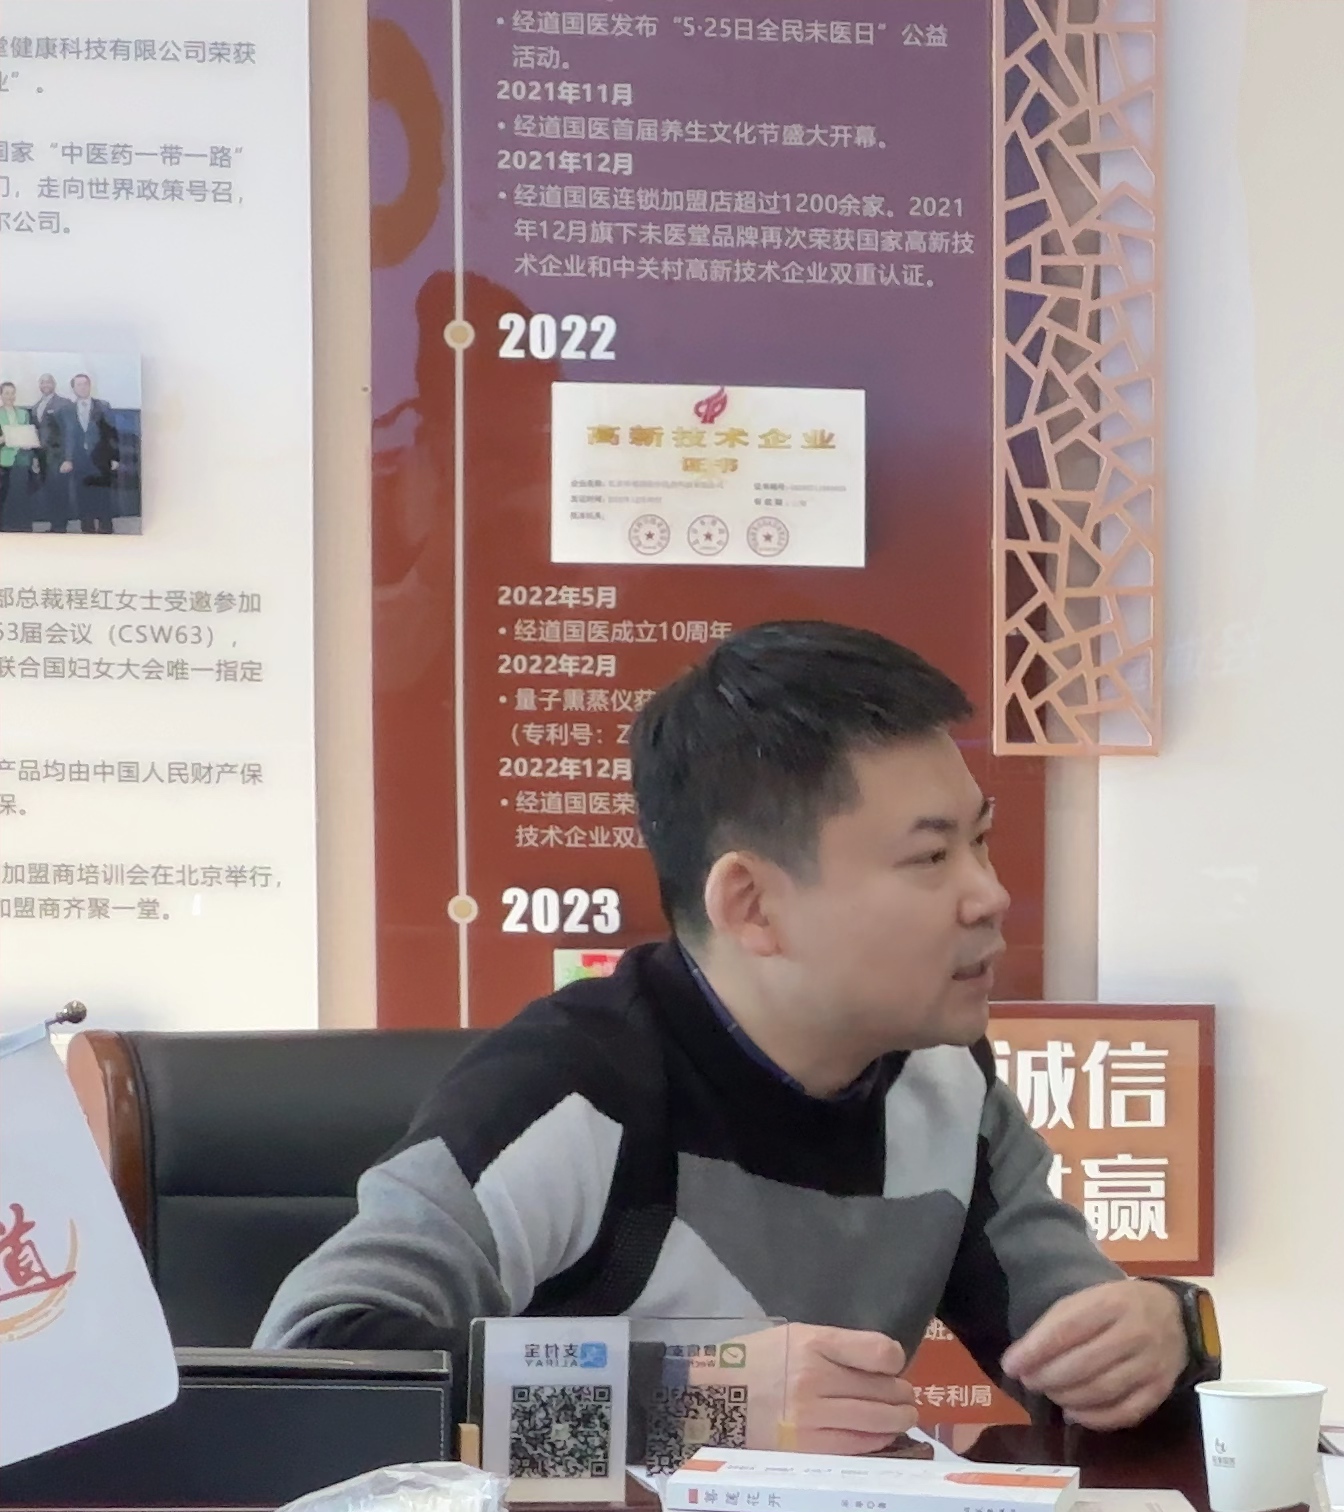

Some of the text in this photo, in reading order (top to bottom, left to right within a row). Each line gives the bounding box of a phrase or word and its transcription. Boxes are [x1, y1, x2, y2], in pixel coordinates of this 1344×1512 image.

[0, 36, 256, 64] 健康科技有限公司荣获
[512, 45, 570, 69] 活动。
[497, 80, 633, 106] 2021年11月
[513, 114, 887, 149] 经道国医首届养生文化节盛大开幕。
[497, 149, 633, 175] 2021年12月
[514, 183, 963, 218] 经道国医连锁加盟店超过1200余家。2021
[514, 219, 974, 255] 年12月旗下未医堂品牌再次荣获国家高新技
[514, 253, 934, 288] 术企业和中关村高新技术企业双重认证。
[498, 313, 617, 361] 2022
[587, 424, 836, 449] 高新技术企业
[498, 586, 617, 609] 2022年5月
[514, 620, 732, 643] 经道国医成立10周年
[0, 656, 263, 682] 联合国妇女大会唯一指定
[498, 654, 617, 677] 2022年2月
[0, 759, 263, 785] 产品均由中国人民财产保
[499, 757, 632, 780] 2022年12月
[2, 862, 281, 888] 加盟商培训会在北京举行，
[501, 887, 620, 934] 2023
[994, 1040, 1168, 1129] 诚信
[1048, 1153, 1168, 1241] 赢
